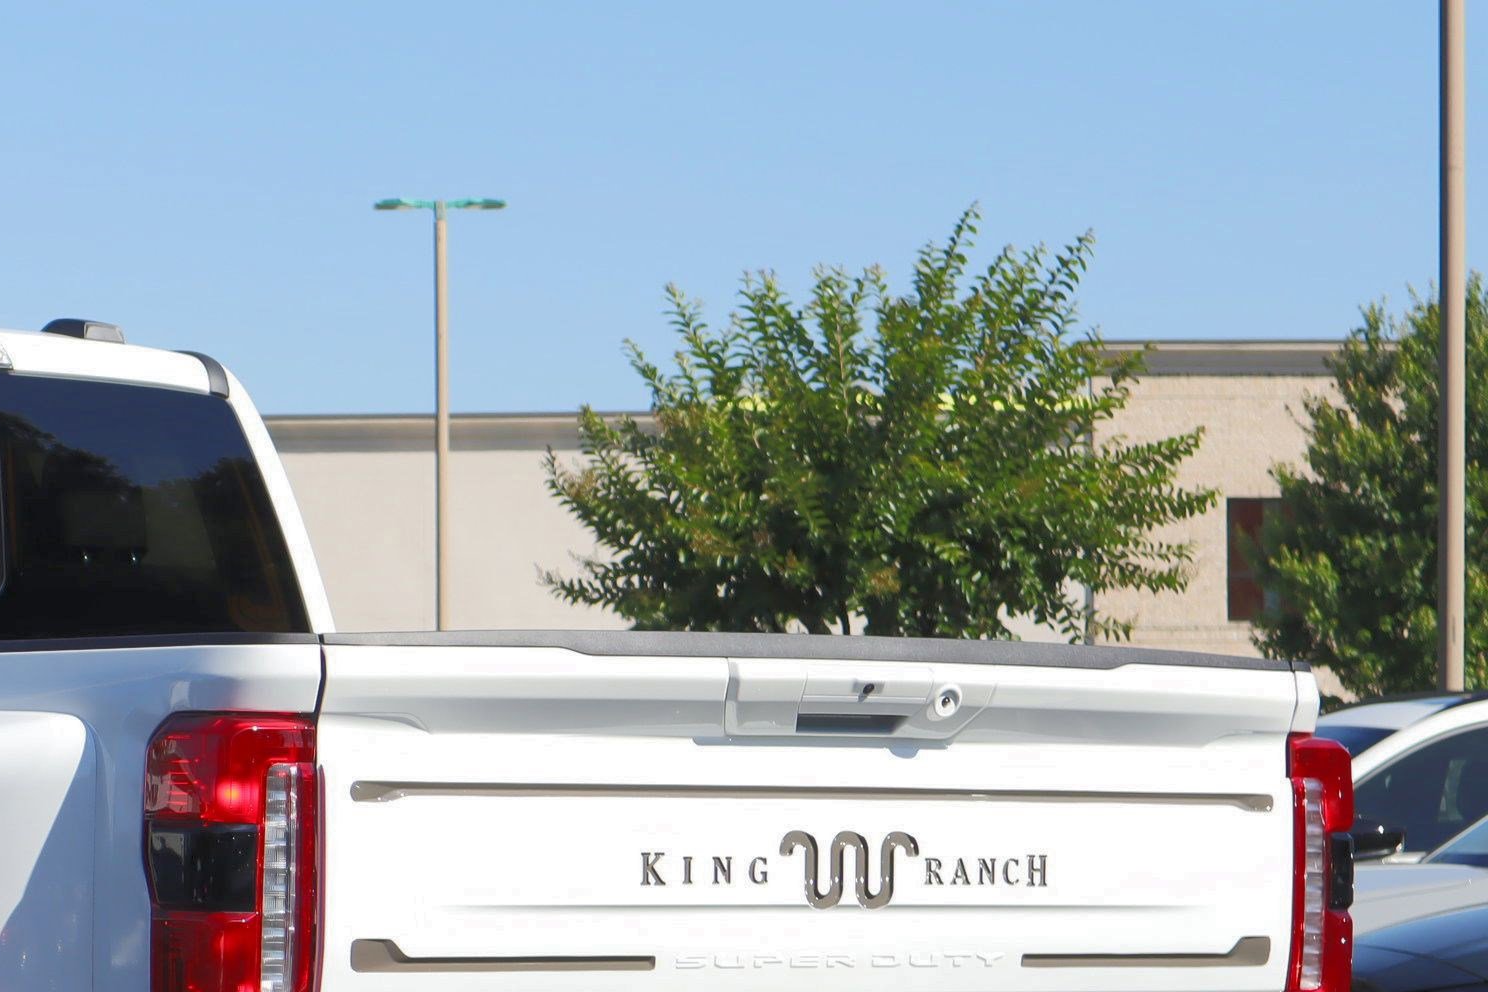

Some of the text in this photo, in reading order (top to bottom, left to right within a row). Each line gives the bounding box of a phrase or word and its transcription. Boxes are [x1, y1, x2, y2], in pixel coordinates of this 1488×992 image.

[639, 851, 1049, 888] KING RANCH
[674, 950, 1005, 970] SUPER DUTY
